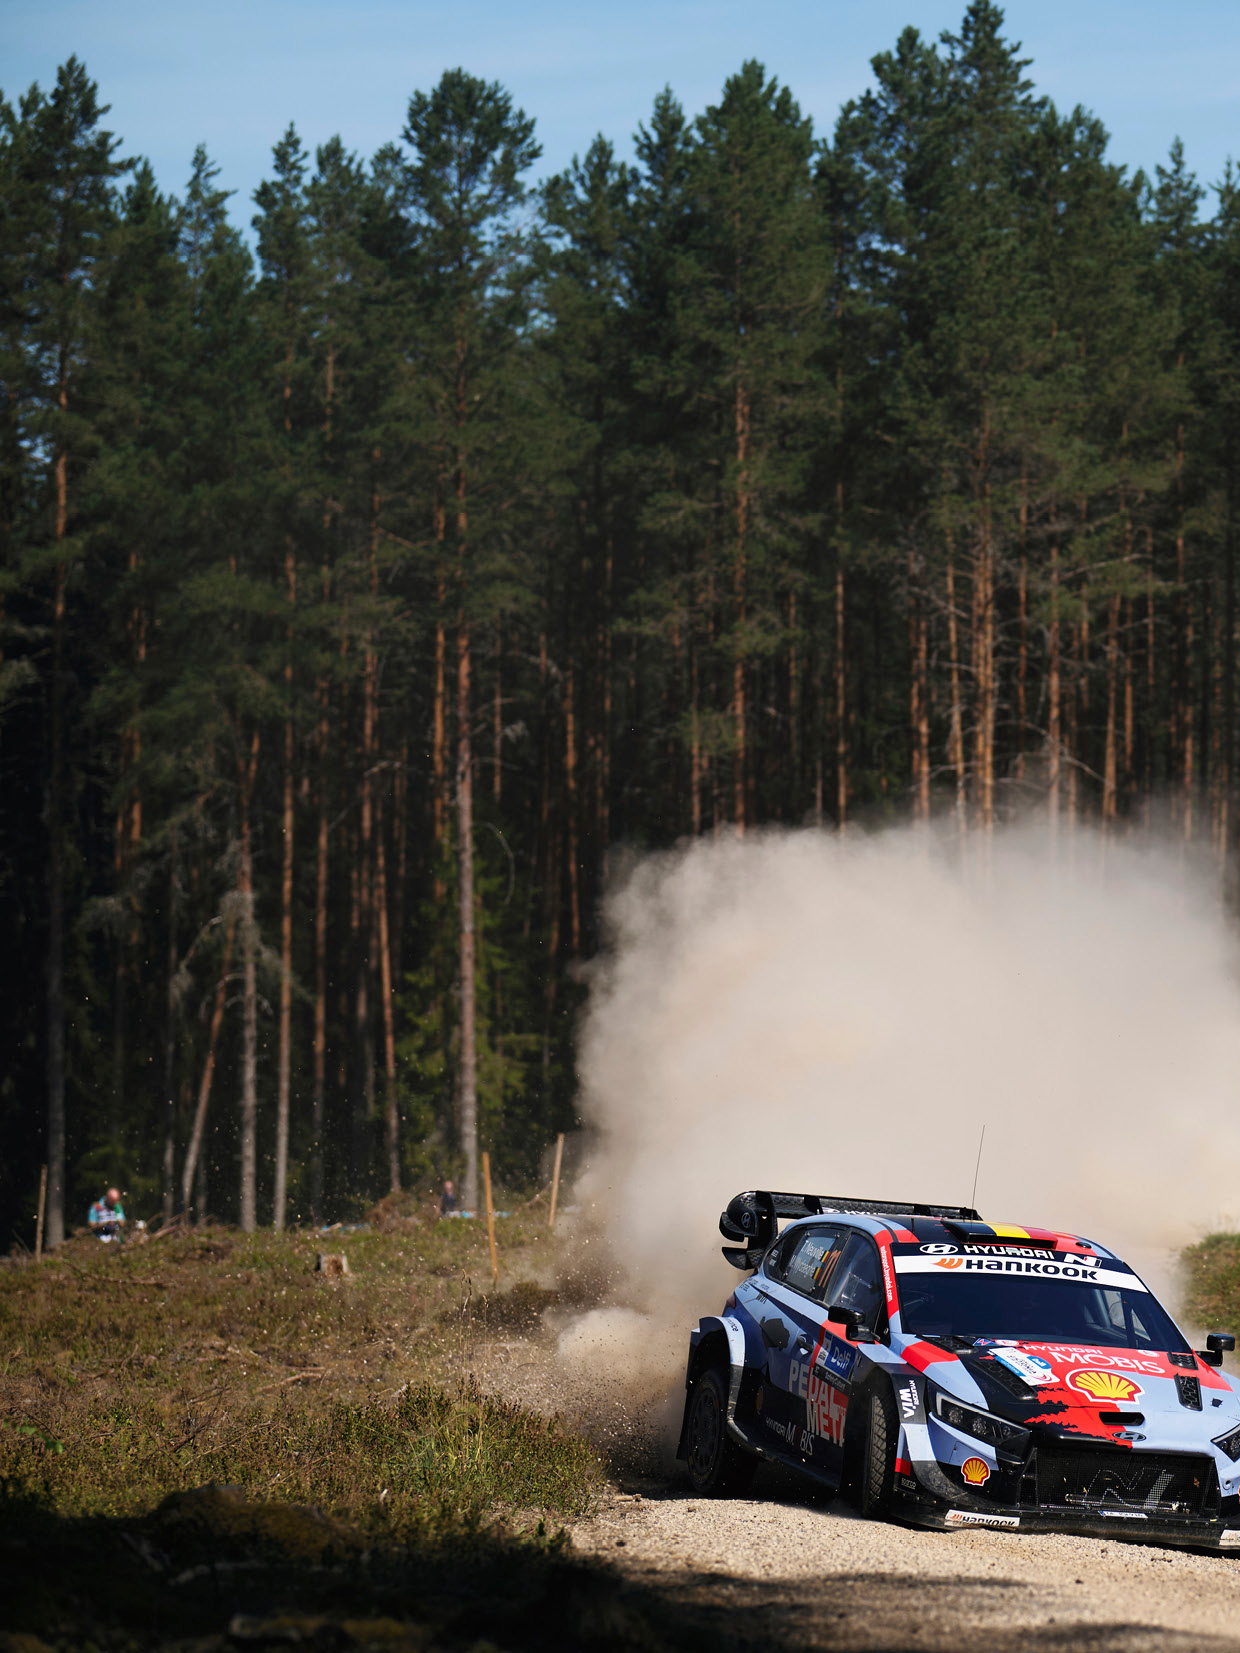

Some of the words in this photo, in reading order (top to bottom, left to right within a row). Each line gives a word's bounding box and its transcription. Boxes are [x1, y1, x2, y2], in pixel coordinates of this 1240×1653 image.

[963, 1244, 1055, 1259] HYUNDAI
[1022, 1344, 1103, 1354] HYUNDAI
[1049, 1351, 1166, 1374] MOBIS
[909, 1380, 919, 1406] HYUNDAI
[765, 1416, 787, 1438] HYUNDAI
[785, 1421, 815, 1456] MOBIS
